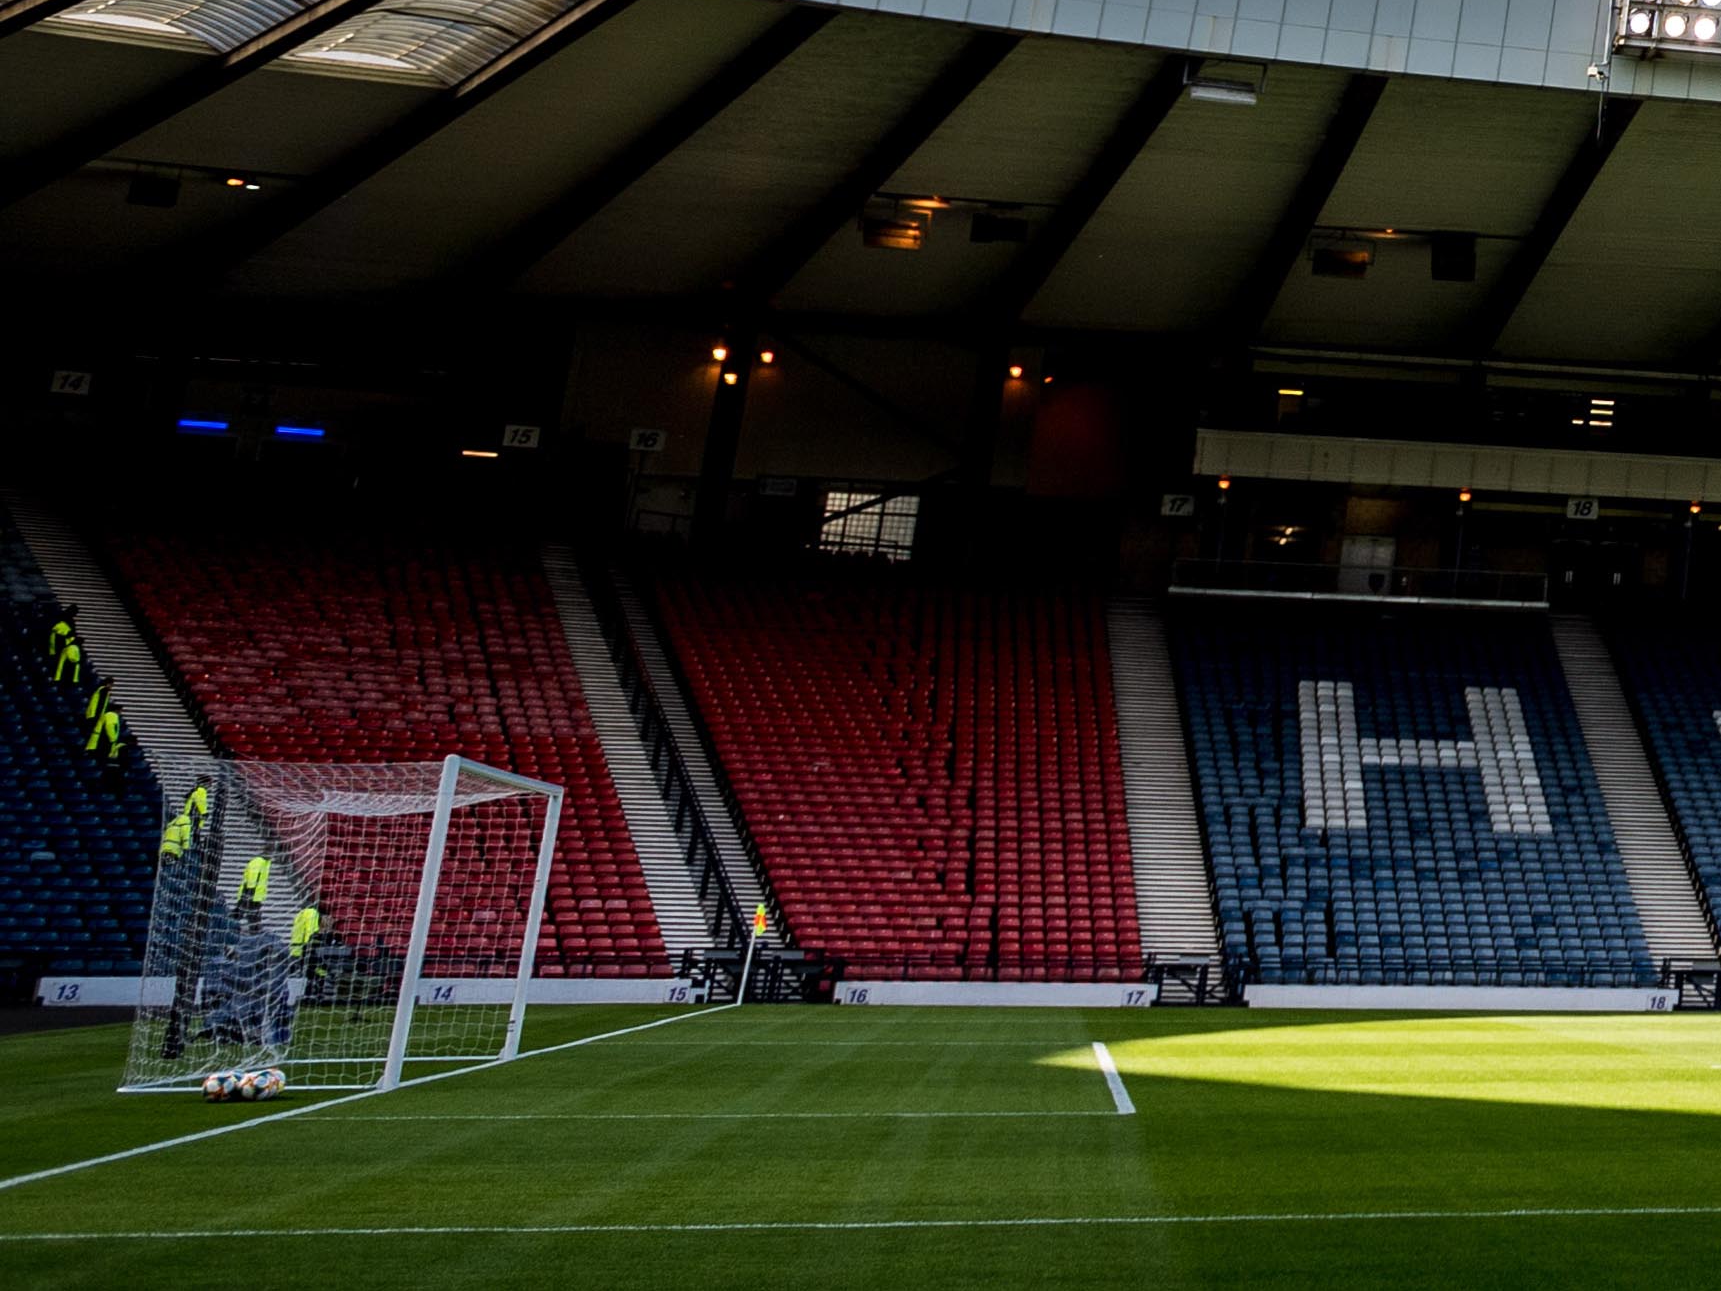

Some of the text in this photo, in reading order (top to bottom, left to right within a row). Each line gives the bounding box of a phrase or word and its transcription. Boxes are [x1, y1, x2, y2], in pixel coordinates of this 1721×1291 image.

[510, 428, 535, 444] 15
[1169, 497, 1189, 512] 17
[1573, 500, 1593, 516] 18
[57, 984, 79, 1000] 13
[434, 986, 453, 1000] 14
[669, 987, 688, 1001] 15
[850, 989, 868, 1003] 16
[1127, 991, 1145, 1005] 17
[1650, 996, 1666, 1010] 18
